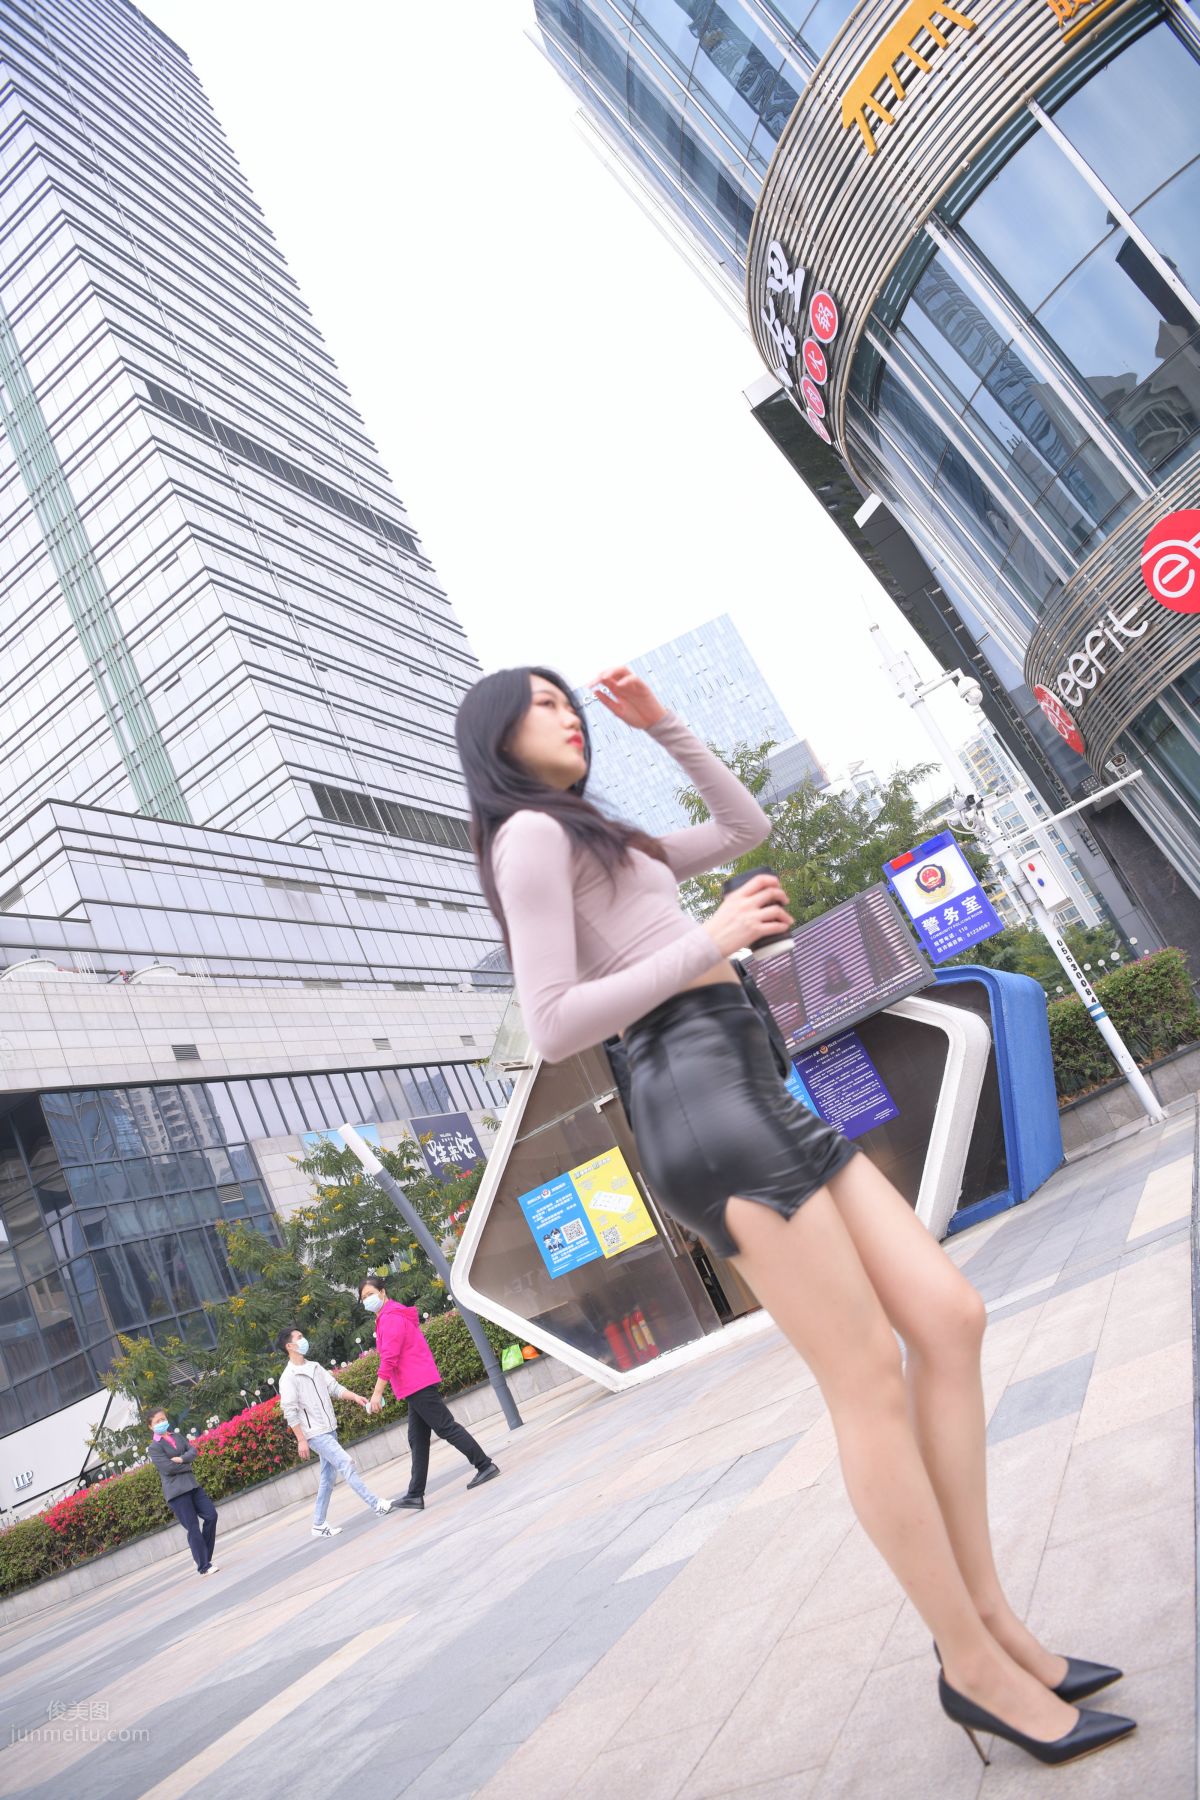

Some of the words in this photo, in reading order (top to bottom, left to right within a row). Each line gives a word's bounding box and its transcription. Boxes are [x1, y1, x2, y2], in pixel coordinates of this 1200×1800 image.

[1057, 604, 1148, 707] eefit
[921, 895, 982, 935] 警务室
[958, 926, 969, 934] 110
[1056, 939, 1097, 1003] 05530084
